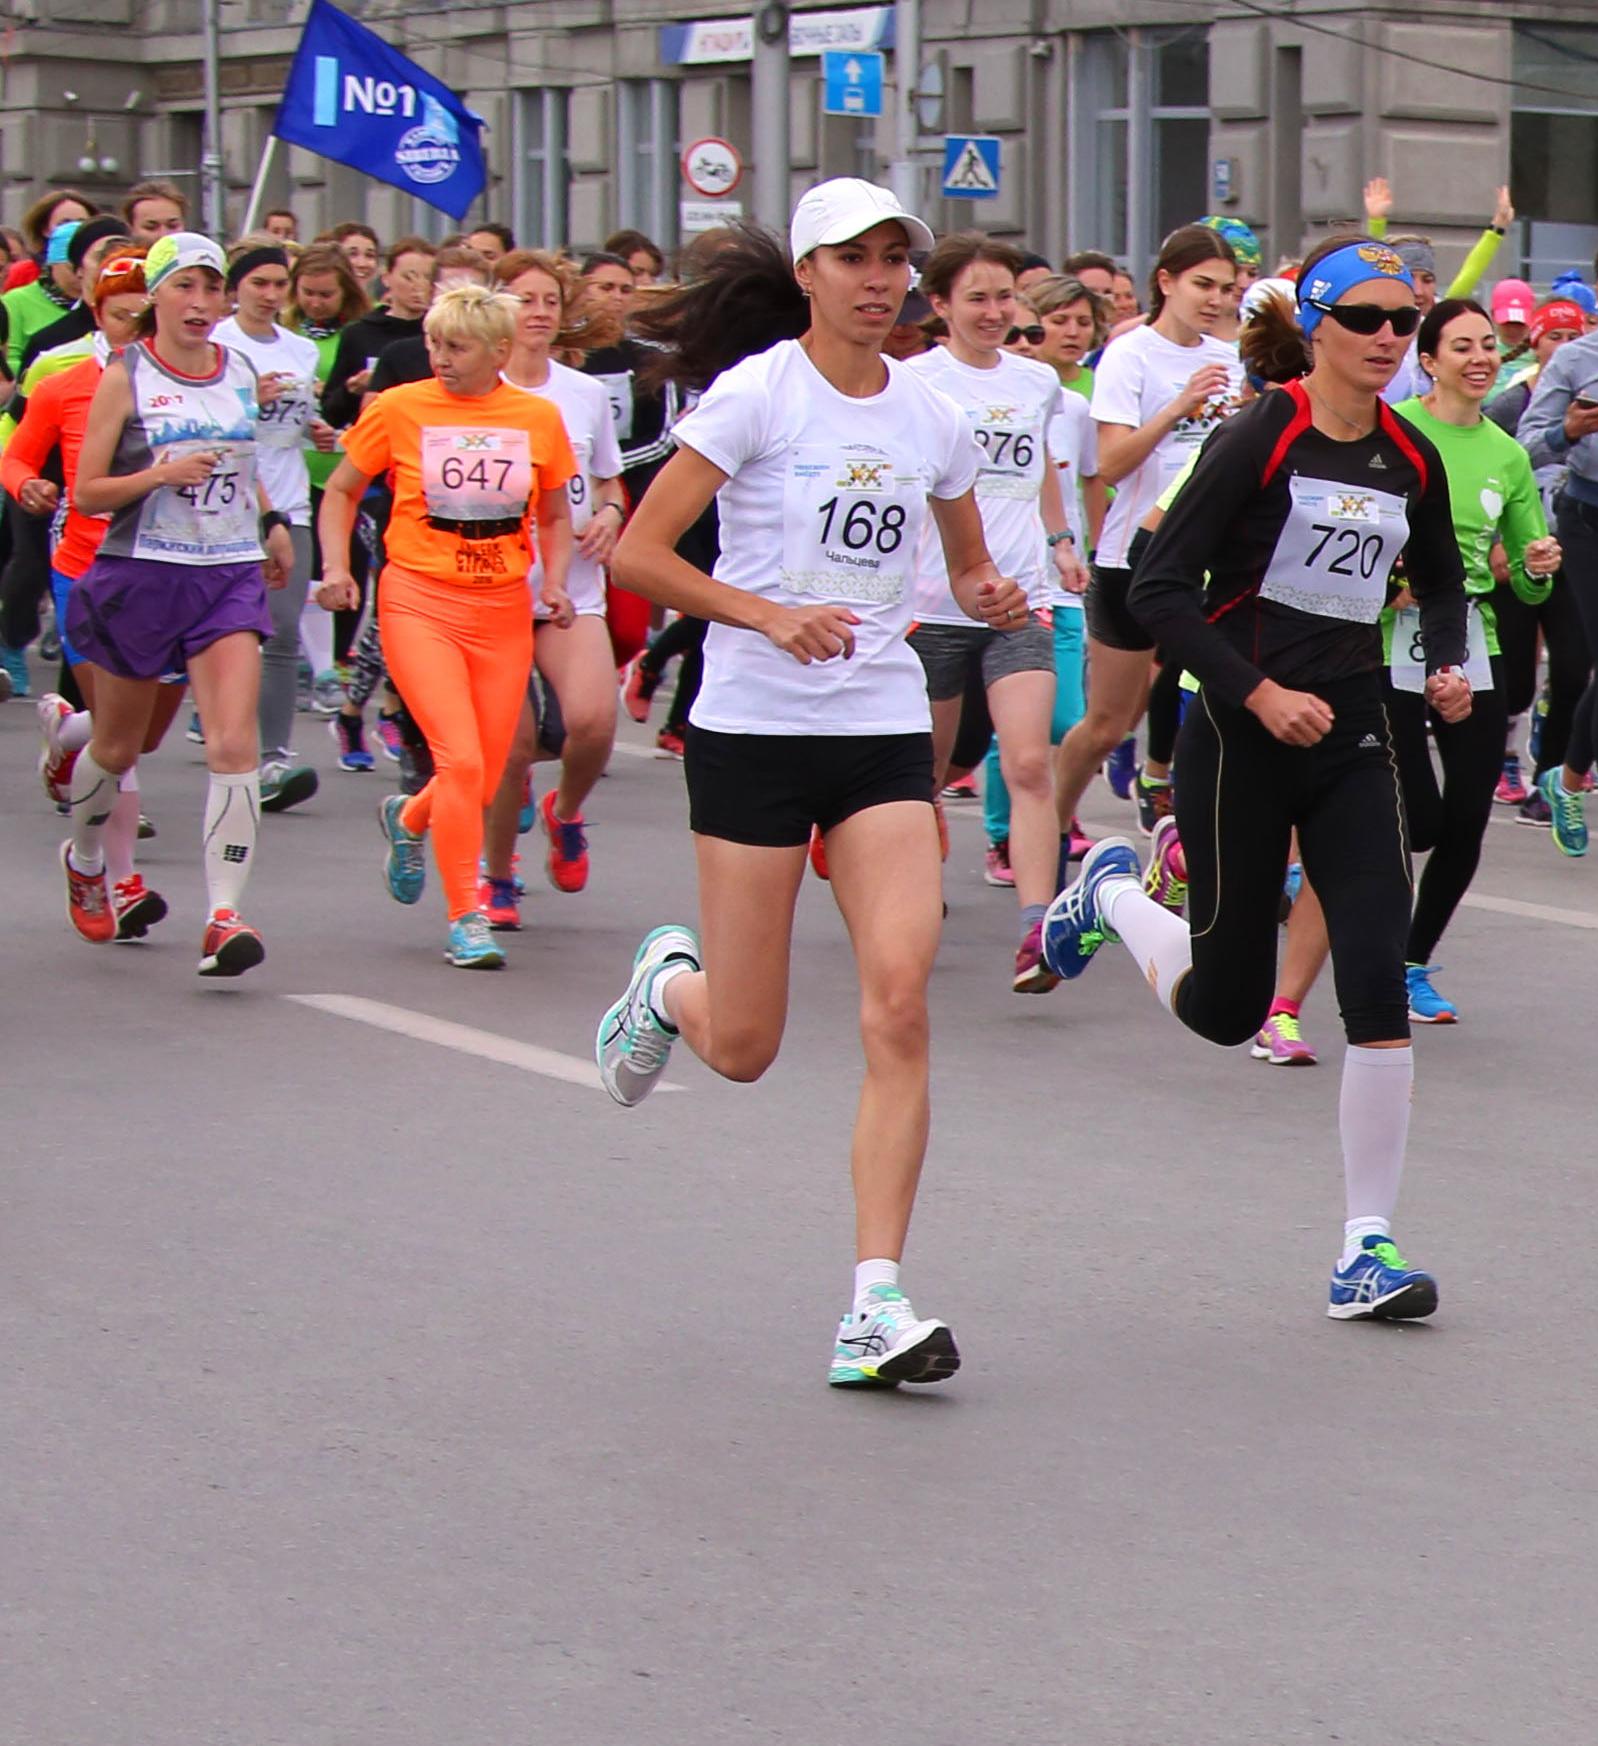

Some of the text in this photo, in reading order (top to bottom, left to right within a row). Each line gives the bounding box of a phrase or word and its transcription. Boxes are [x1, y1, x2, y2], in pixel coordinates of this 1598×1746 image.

[177, 472, 239, 507] 475
[442, 457, 514, 491] 647
[818, 496, 906, 554] 168
[825, 550, 881, 569] Чальцева
[1304, 524, 1384, 580] 720
